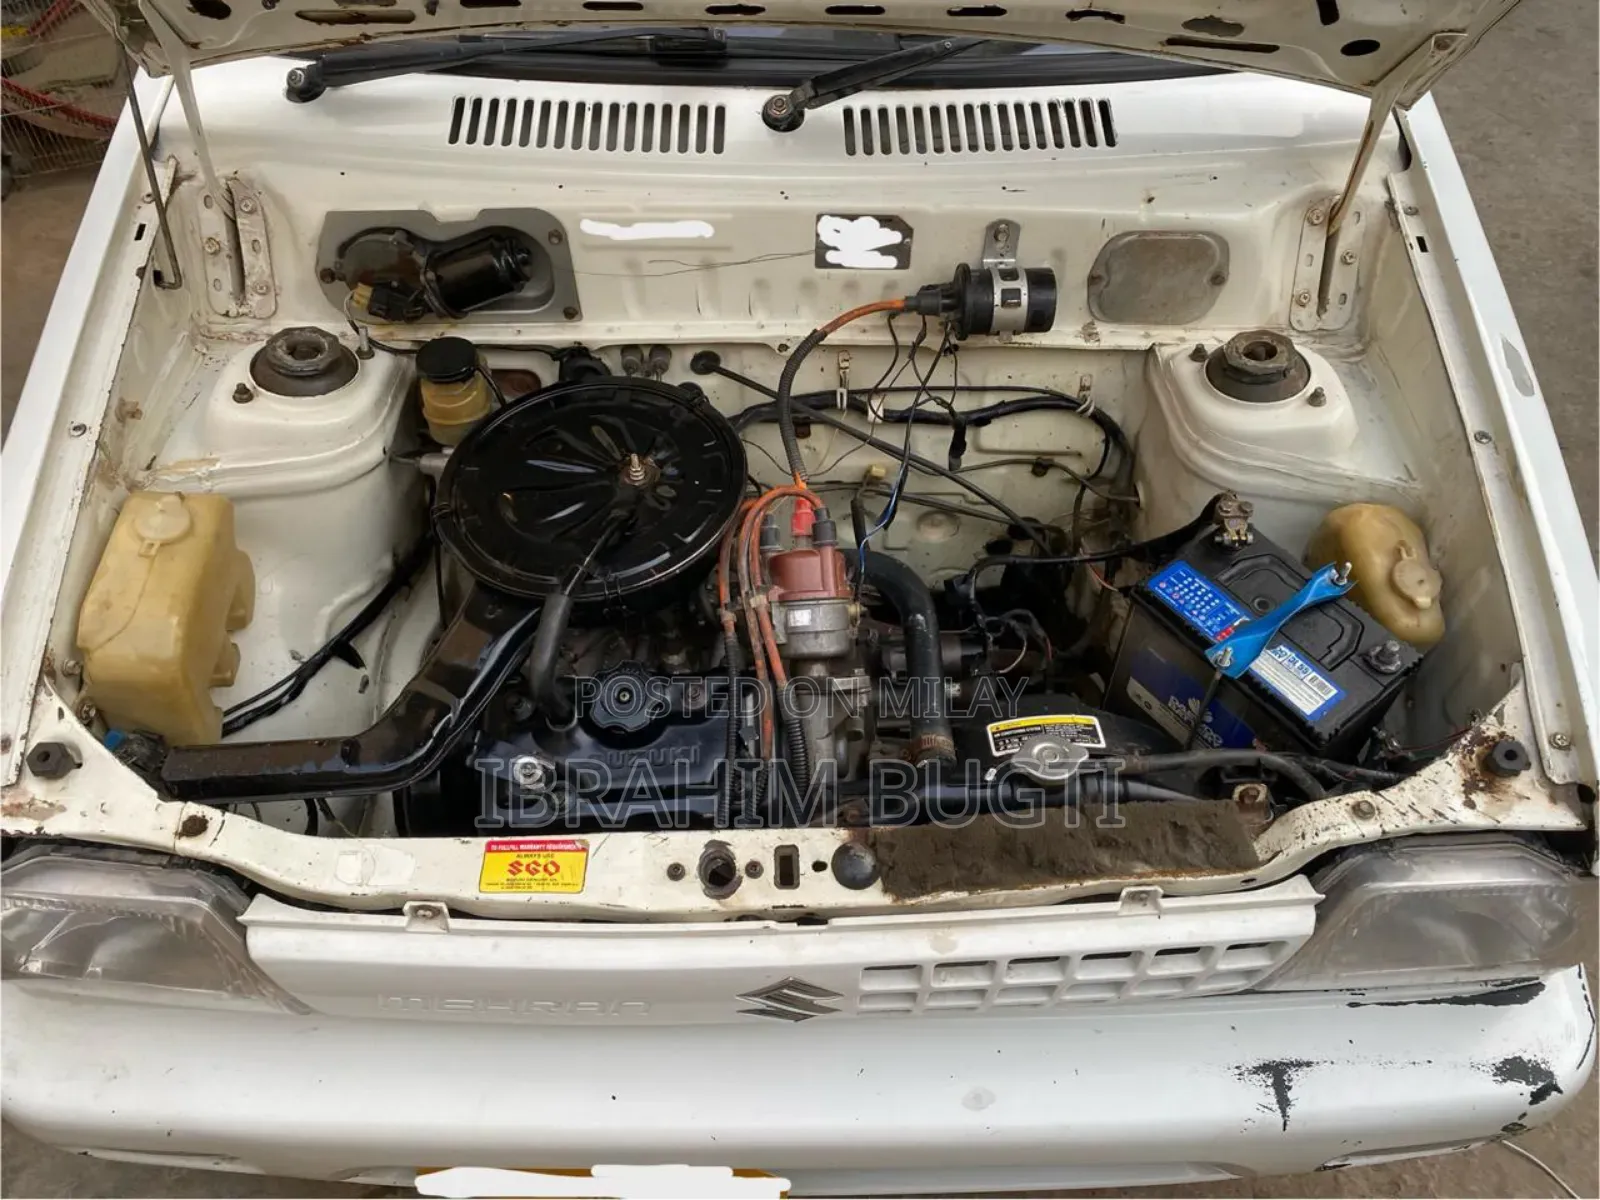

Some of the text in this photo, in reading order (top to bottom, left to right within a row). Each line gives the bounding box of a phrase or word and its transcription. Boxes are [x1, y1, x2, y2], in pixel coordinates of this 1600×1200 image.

[587, 744, 702, 770] SUZUKI
[520, 843, 545, 851] WARRANTY
[507, 860, 561, 876] SGO
[377, 994, 651, 1017] MEHRAN
